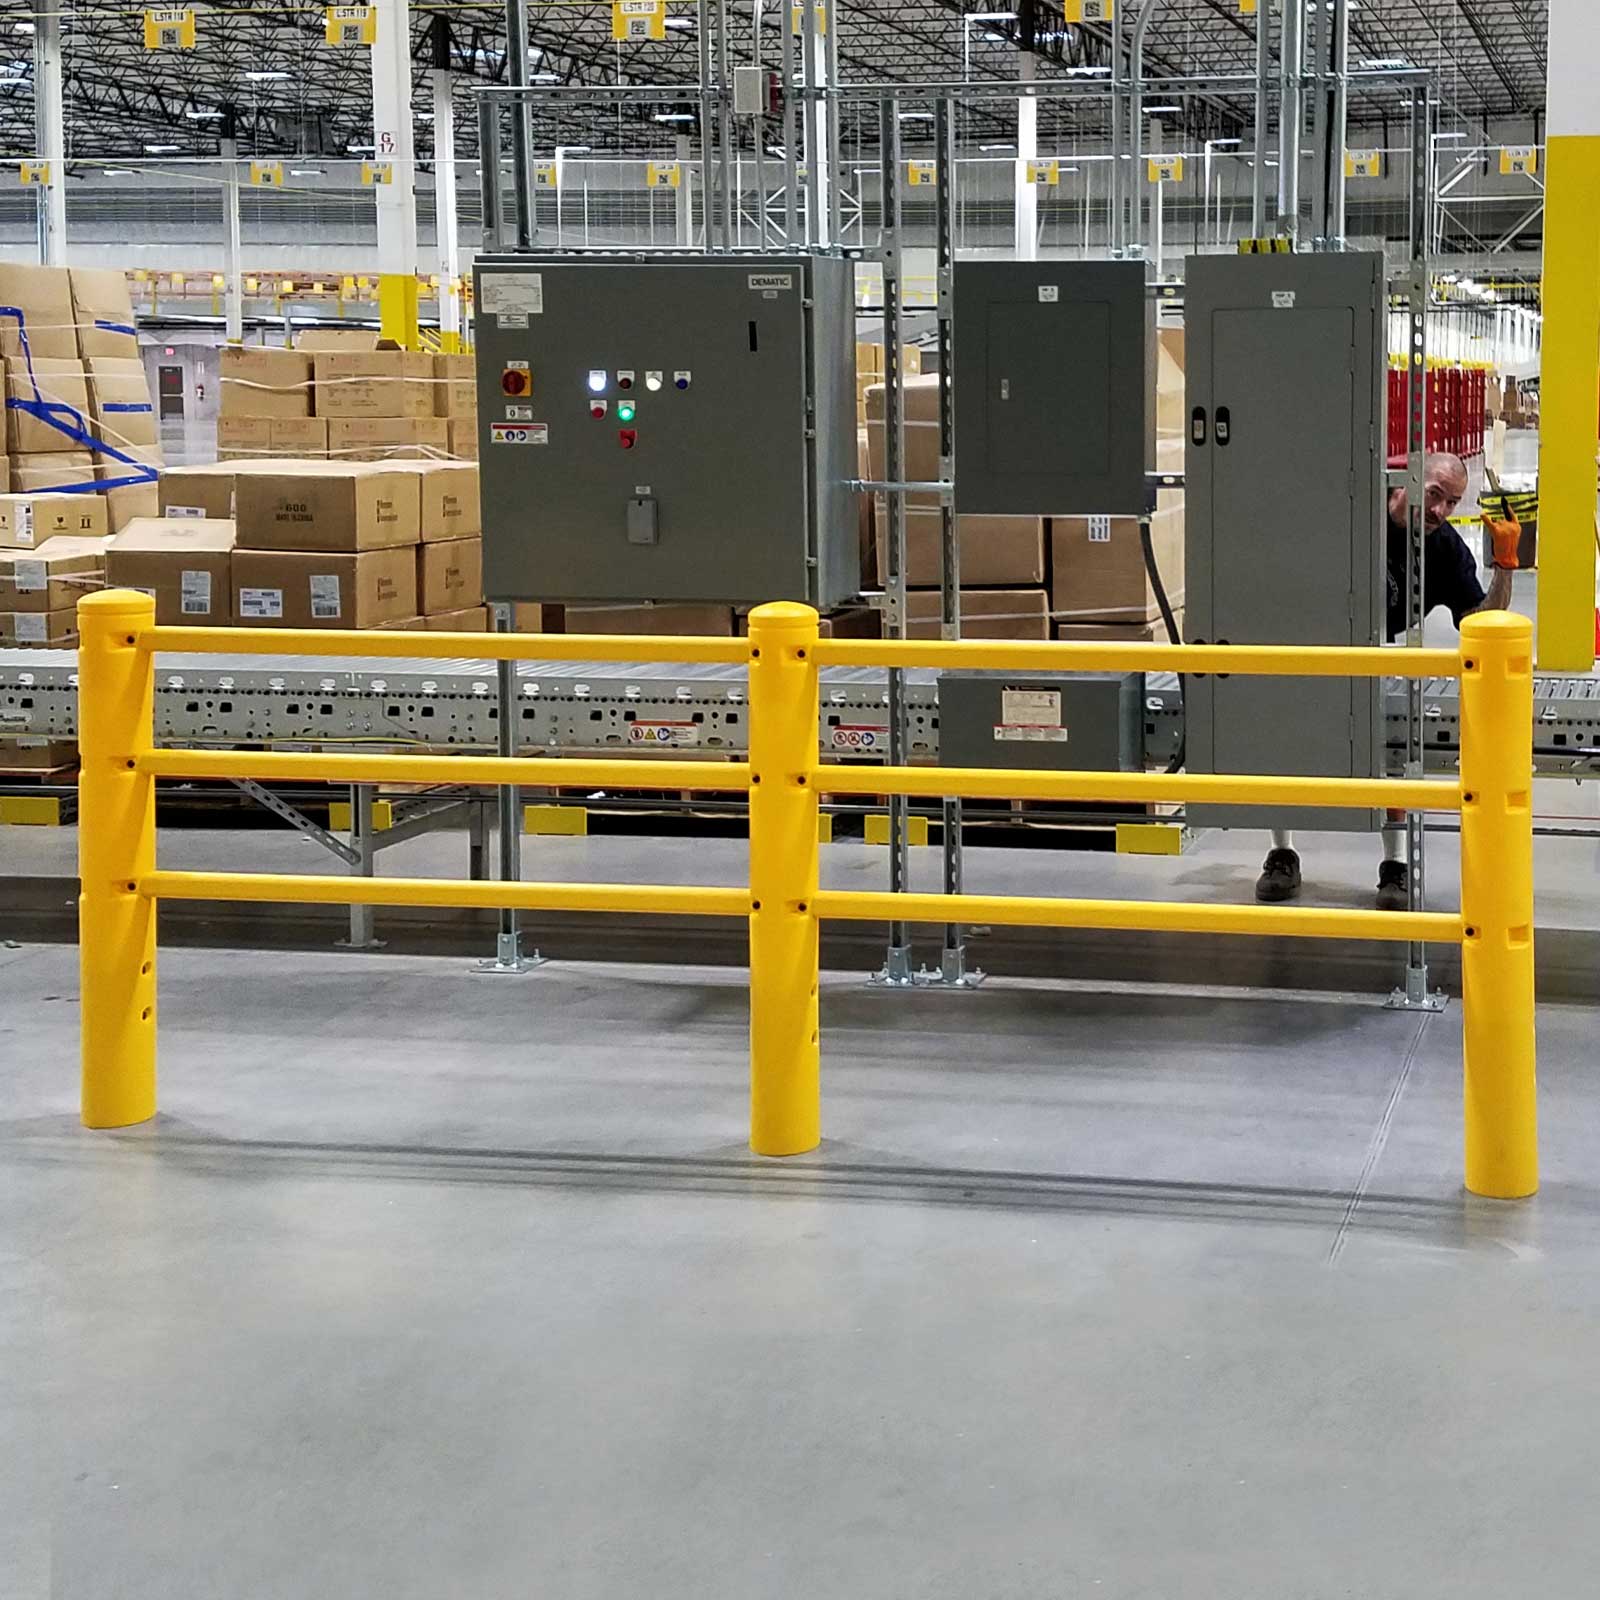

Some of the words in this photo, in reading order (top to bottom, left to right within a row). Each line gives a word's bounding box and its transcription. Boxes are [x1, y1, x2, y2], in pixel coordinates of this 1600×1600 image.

[381, 131, 391, 143] G
[378, 142, 394, 153] 17
[751, 277, 789, 287] DEMATIC
